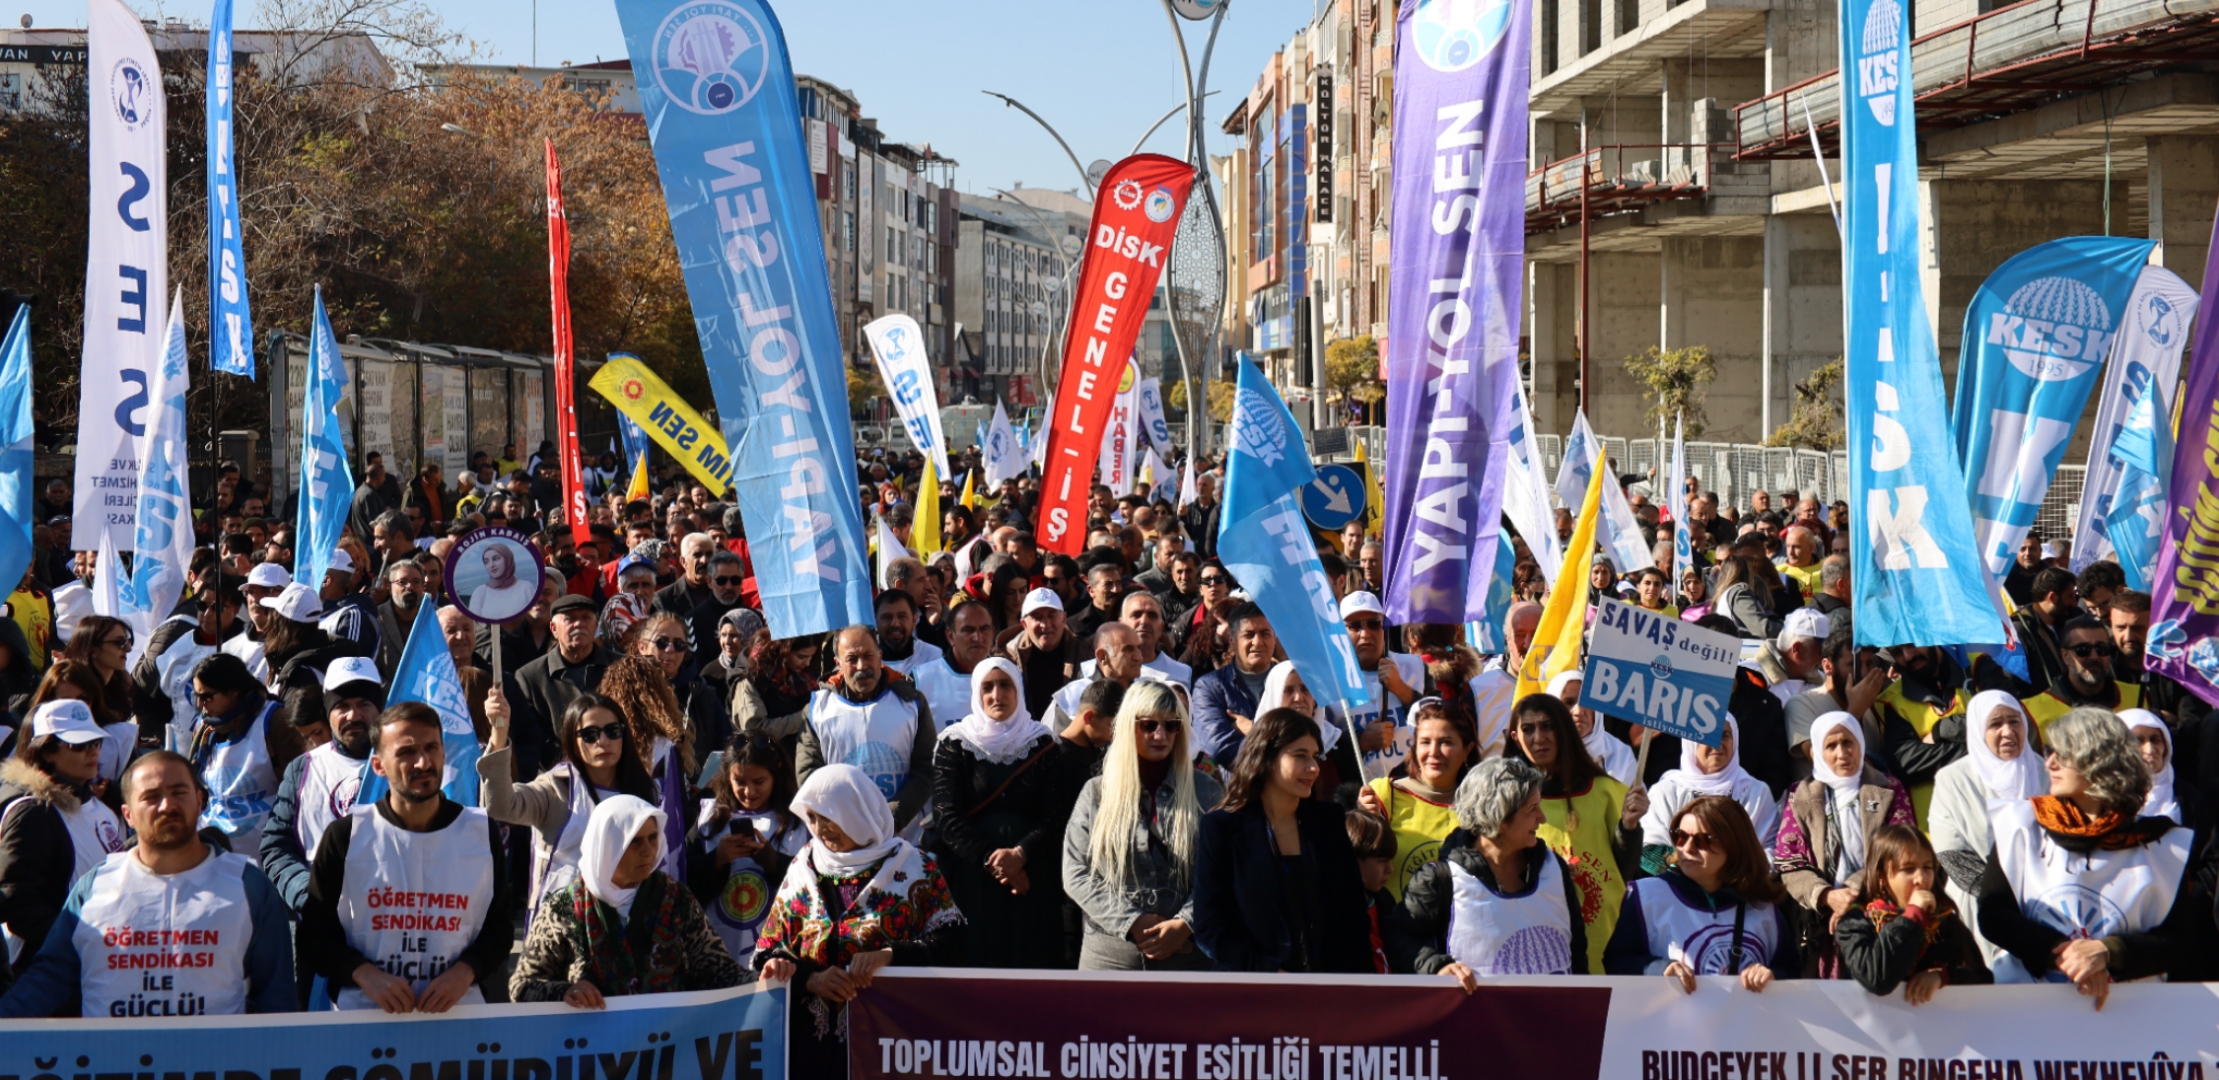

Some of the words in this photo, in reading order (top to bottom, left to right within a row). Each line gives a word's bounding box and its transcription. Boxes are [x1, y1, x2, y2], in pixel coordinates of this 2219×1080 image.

[1432, 100, 1483, 236] SEN
[1095, 224, 1165, 268] DİSK
[1988, 312, 2115, 365] KESK
[2028, 358, 2064, 377] 1995
[1602, 602, 1678, 651] SAVAŞ
[1679, 636, 1734, 666] değil!
[1650, 660, 1674, 674] KESK
[1589, 659, 1722, 741] BARIŞ
[1579, 850, 1613, 884] SEN
[367, 886, 469, 911] ÖĞRETMEN
[371, 910, 462, 932] SENDİKASI
[103, 926, 220, 948] ÖĞRETMEN
[401, 932, 428, 954] İLE
[107, 948, 215, 971] SENDİKASI
[142, 971, 174, 992] İLE
[695, 1029, 763, 1080] VE
[878, 1037, 1051, 1078] TOPLUMSAL
[1061, 1034, 1187, 1080] CİNSİYET
